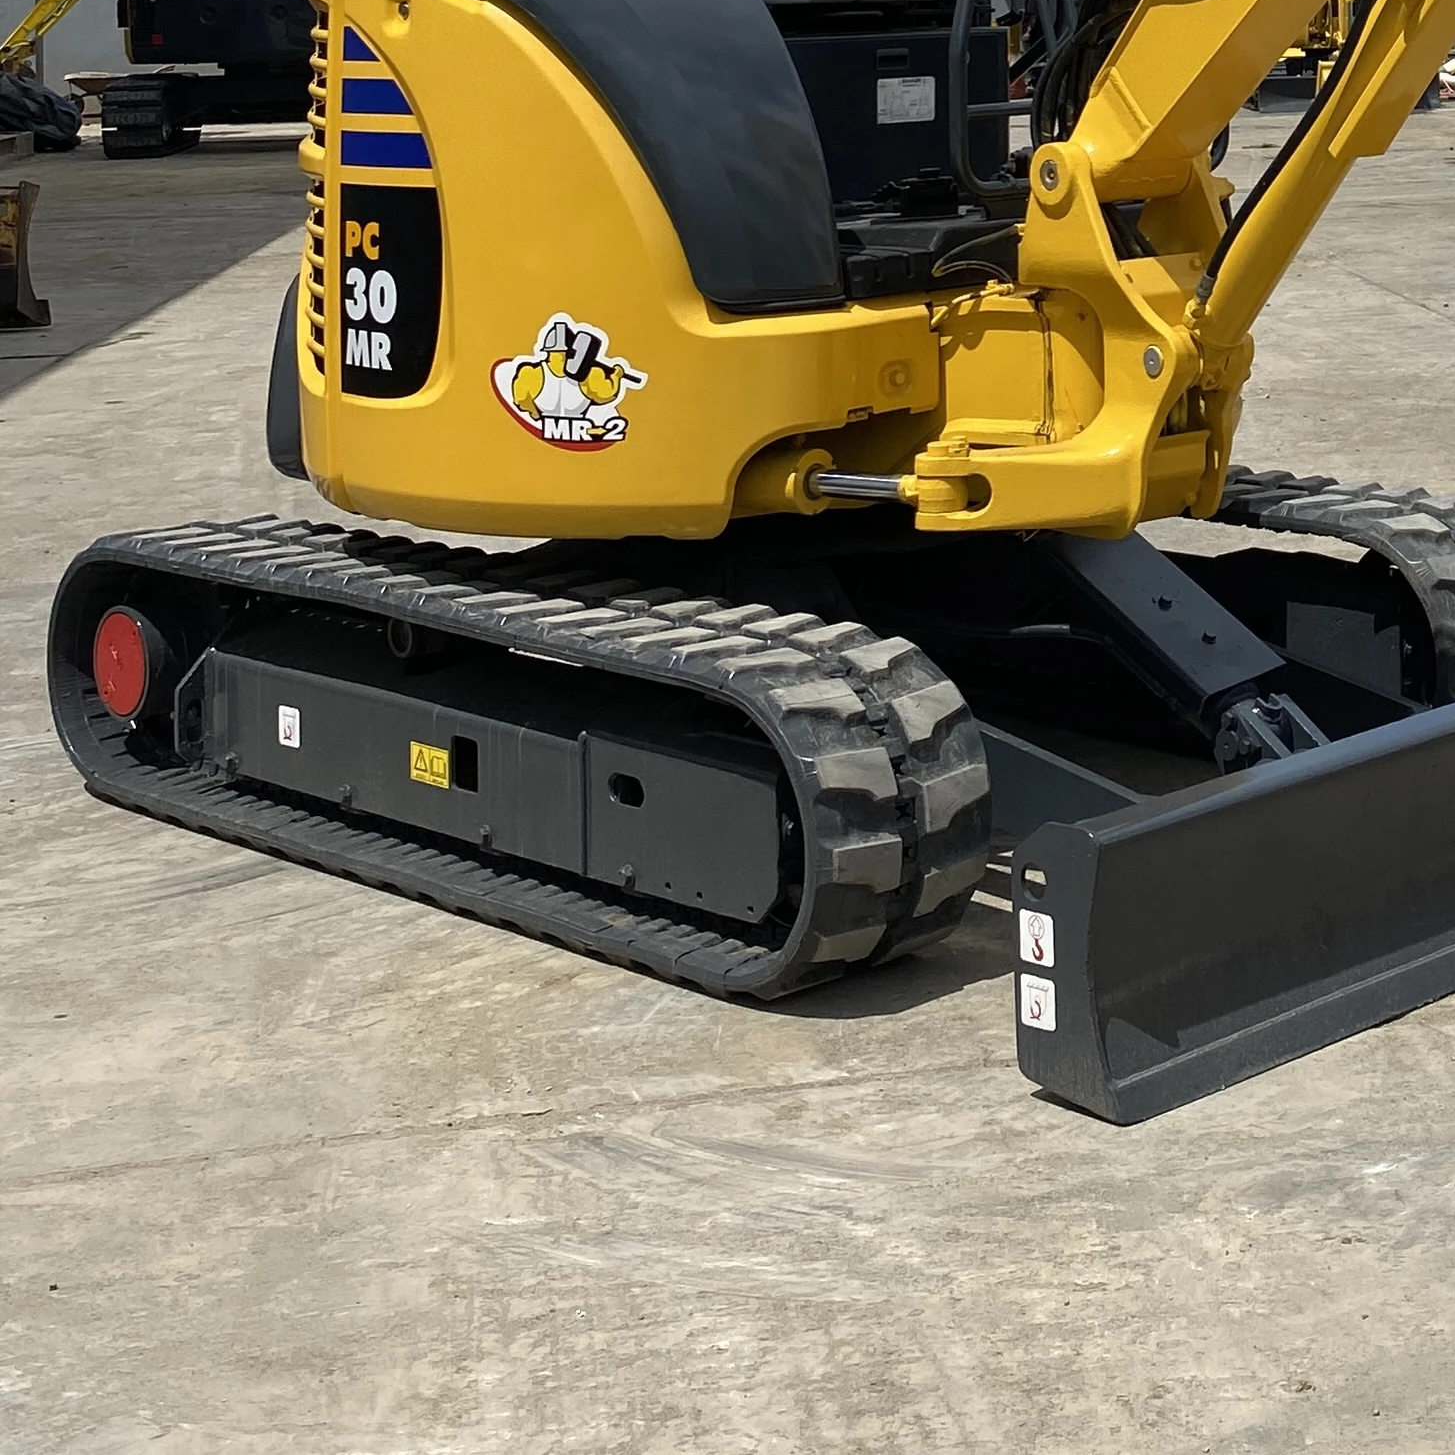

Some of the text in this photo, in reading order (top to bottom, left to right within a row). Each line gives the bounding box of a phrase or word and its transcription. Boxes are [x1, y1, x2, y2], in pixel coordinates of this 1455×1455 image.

[345, 221, 379, 260] PC
[345, 268, 397, 324] 30
[345, 328, 392, 371] MR
